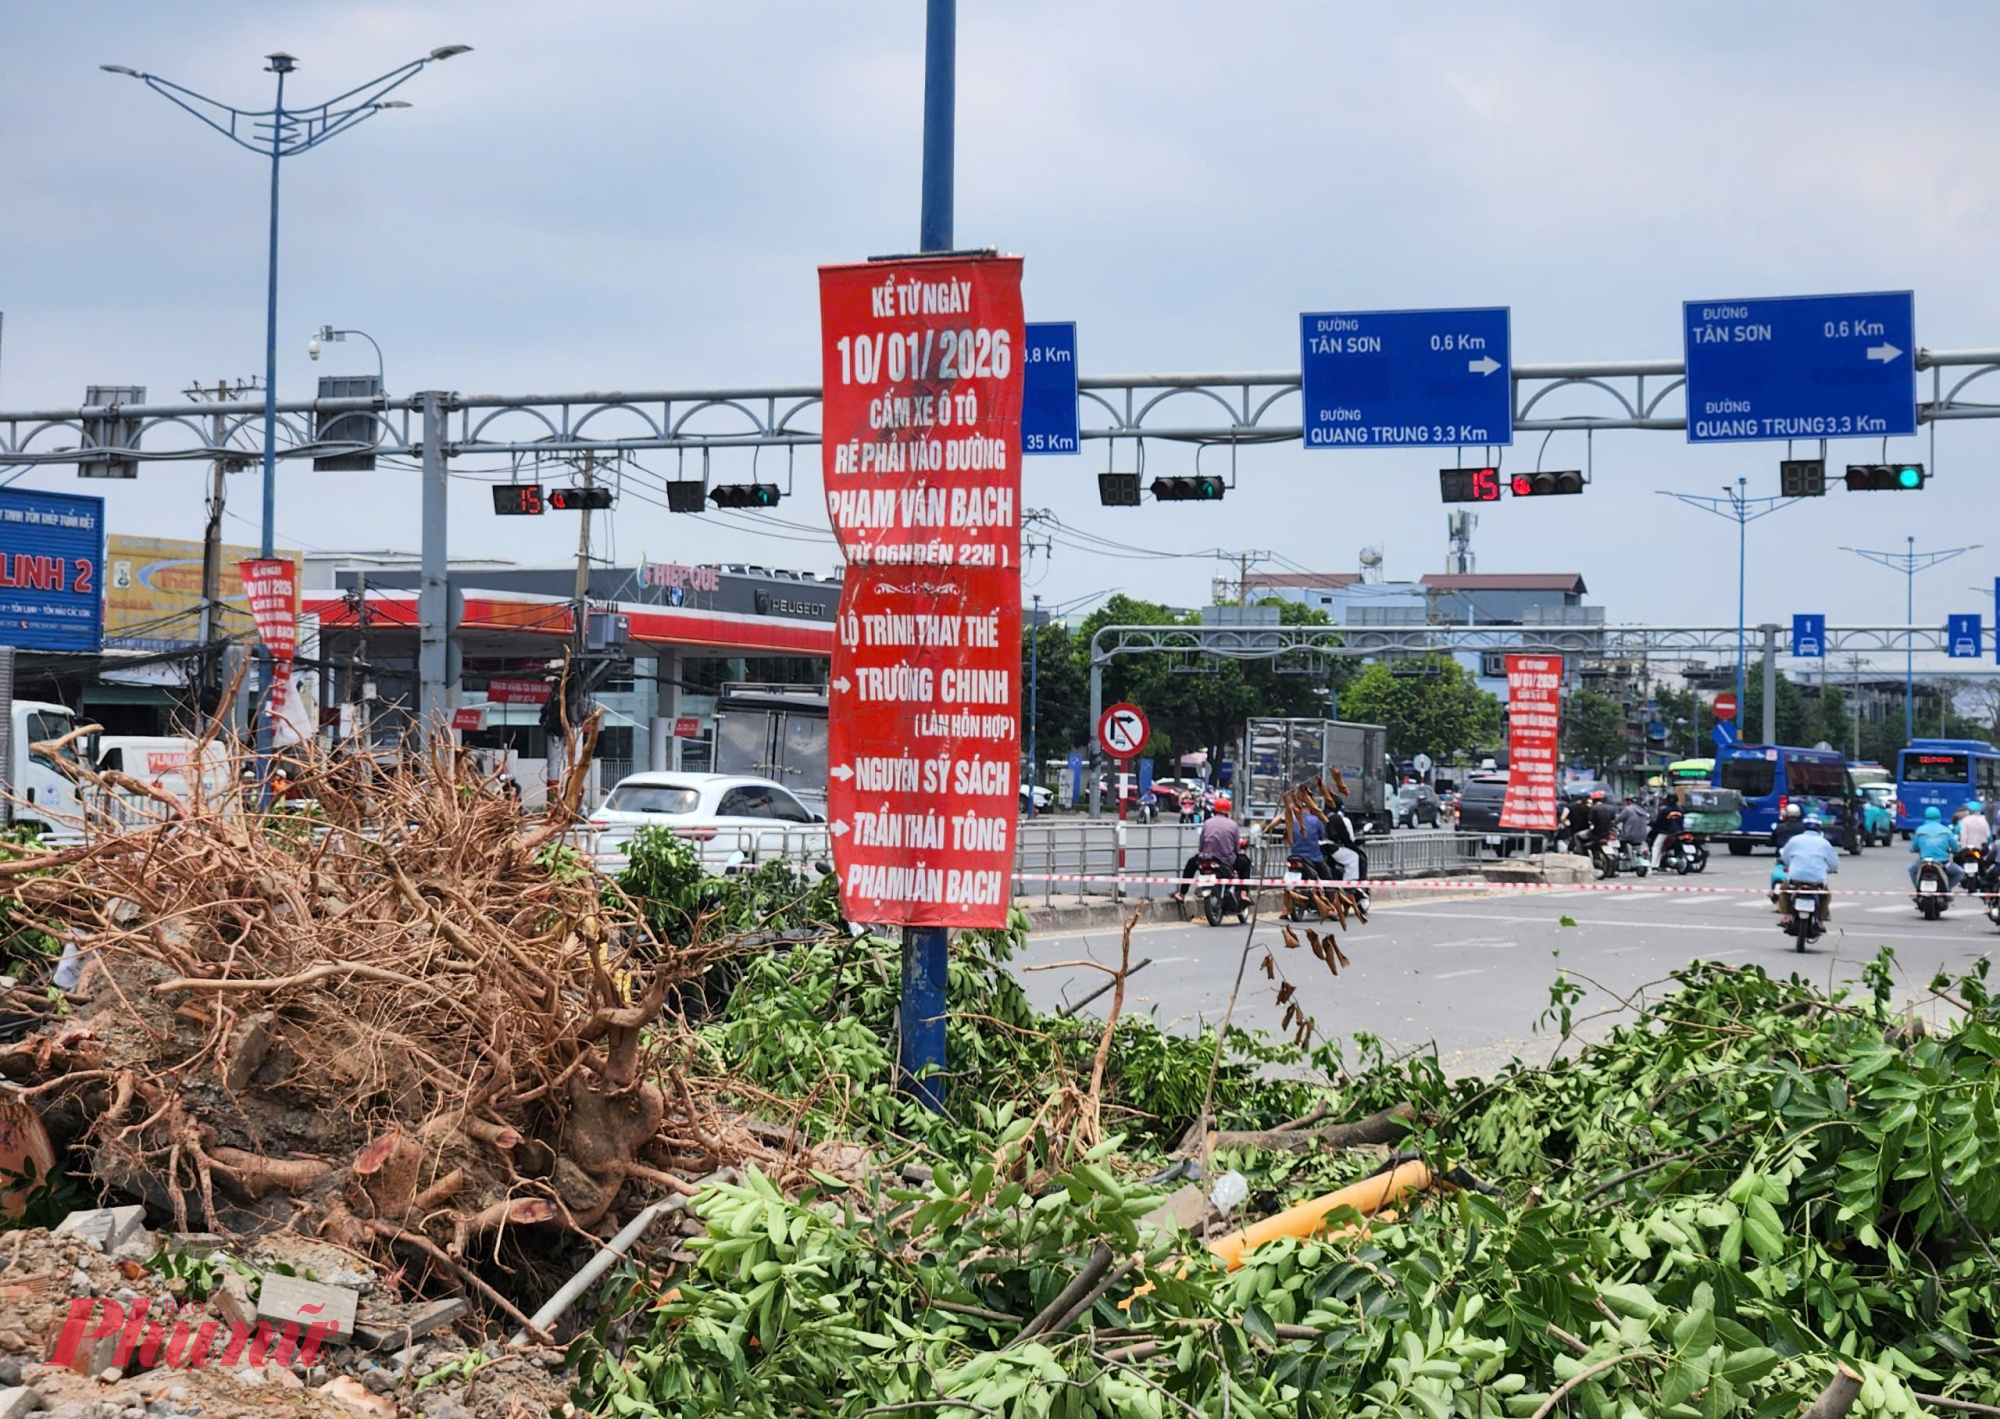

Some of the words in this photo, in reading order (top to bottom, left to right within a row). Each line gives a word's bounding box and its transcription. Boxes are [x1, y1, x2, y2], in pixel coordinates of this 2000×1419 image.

[872, 274, 894, 317] KỂ
[897, 281, 921, 316] TỪ
[924, 276, 971, 315] NGÀY
[1317, 317, 1359, 332] ĐƯỜNG
[1703, 304, 1748, 319] ĐƯỜNG
[1309, 335, 1342, 354] TÂN
[1347, 335, 1381, 353] SƠN
[1458, 334, 1485, 349] Km
[1693, 324, 1728, 343] TÂN
[1734, 324, 1772, 341] SƠN
[1855, 320, 1884, 336] Km
[1046, 347, 1070, 362] Km
[870, 387, 910, 429] CẤM
[914, 396, 933, 426] XE
[938, 390, 952, 427] Ô
[955, 389, 977, 427] TÔ
[1320, 408, 1361, 421] ĐƯỜNG
[1705, 398, 1751, 414] ĐƯỜNG
[1311, 427, 1368, 444] QUANG
[1372, 426, 1428, 443] TRUNG
[1460, 425, 1487, 441] Km
[1696, 420, 1758, 437] QUANG
[1762, 417, 1825, 435] TRUNG
[1857, 415, 1886, 431] Km
[835, 437, 859, 474] RẼ
[861, 432, 906, 473] PHẢI
[909, 433, 941, 471] VÀO
[945, 431, 1006, 471] ĐƯỜNG
[1027, 435, 1043, 449] 35
[1048, 434, 1073, 449] Km
[1472, 469, 1498, 501] 15
[521, 486, 541, 513] 15
[828, 487, 896, 537] PHẠM
[900, 478, 947, 528] VĂN
[949, 486, 1013, 537] BẠCH
[958, 544, 995, 567] 22H
[0, 552, 64, 591] LINH
[74, 559, 93, 594] 2
[772, 600, 826, 616] PEUGEOT
[840, 609, 859, 653] LỘ
[862, 608, 914, 646] TRÌNH
[916, 614, 961, 647] THAY
[965, 607, 999, 647] THẾ
[856, 659, 933, 702] TRƯỜNG
[941, 668, 1009, 704] CHINH
[951, 707, 979, 738] HỖN
[923, 753, 951, 794] SỸ
[955, 753, 1010, 796] SÁCH
[854, 801, 902, 847] TRẦN
[905, 808, 945, 850] THÁI
[952, 809, 1006, 851] TÔNG
[846, 863, 904, 907] PHẠM
[946, 868, 1001, 911] BẠCH
